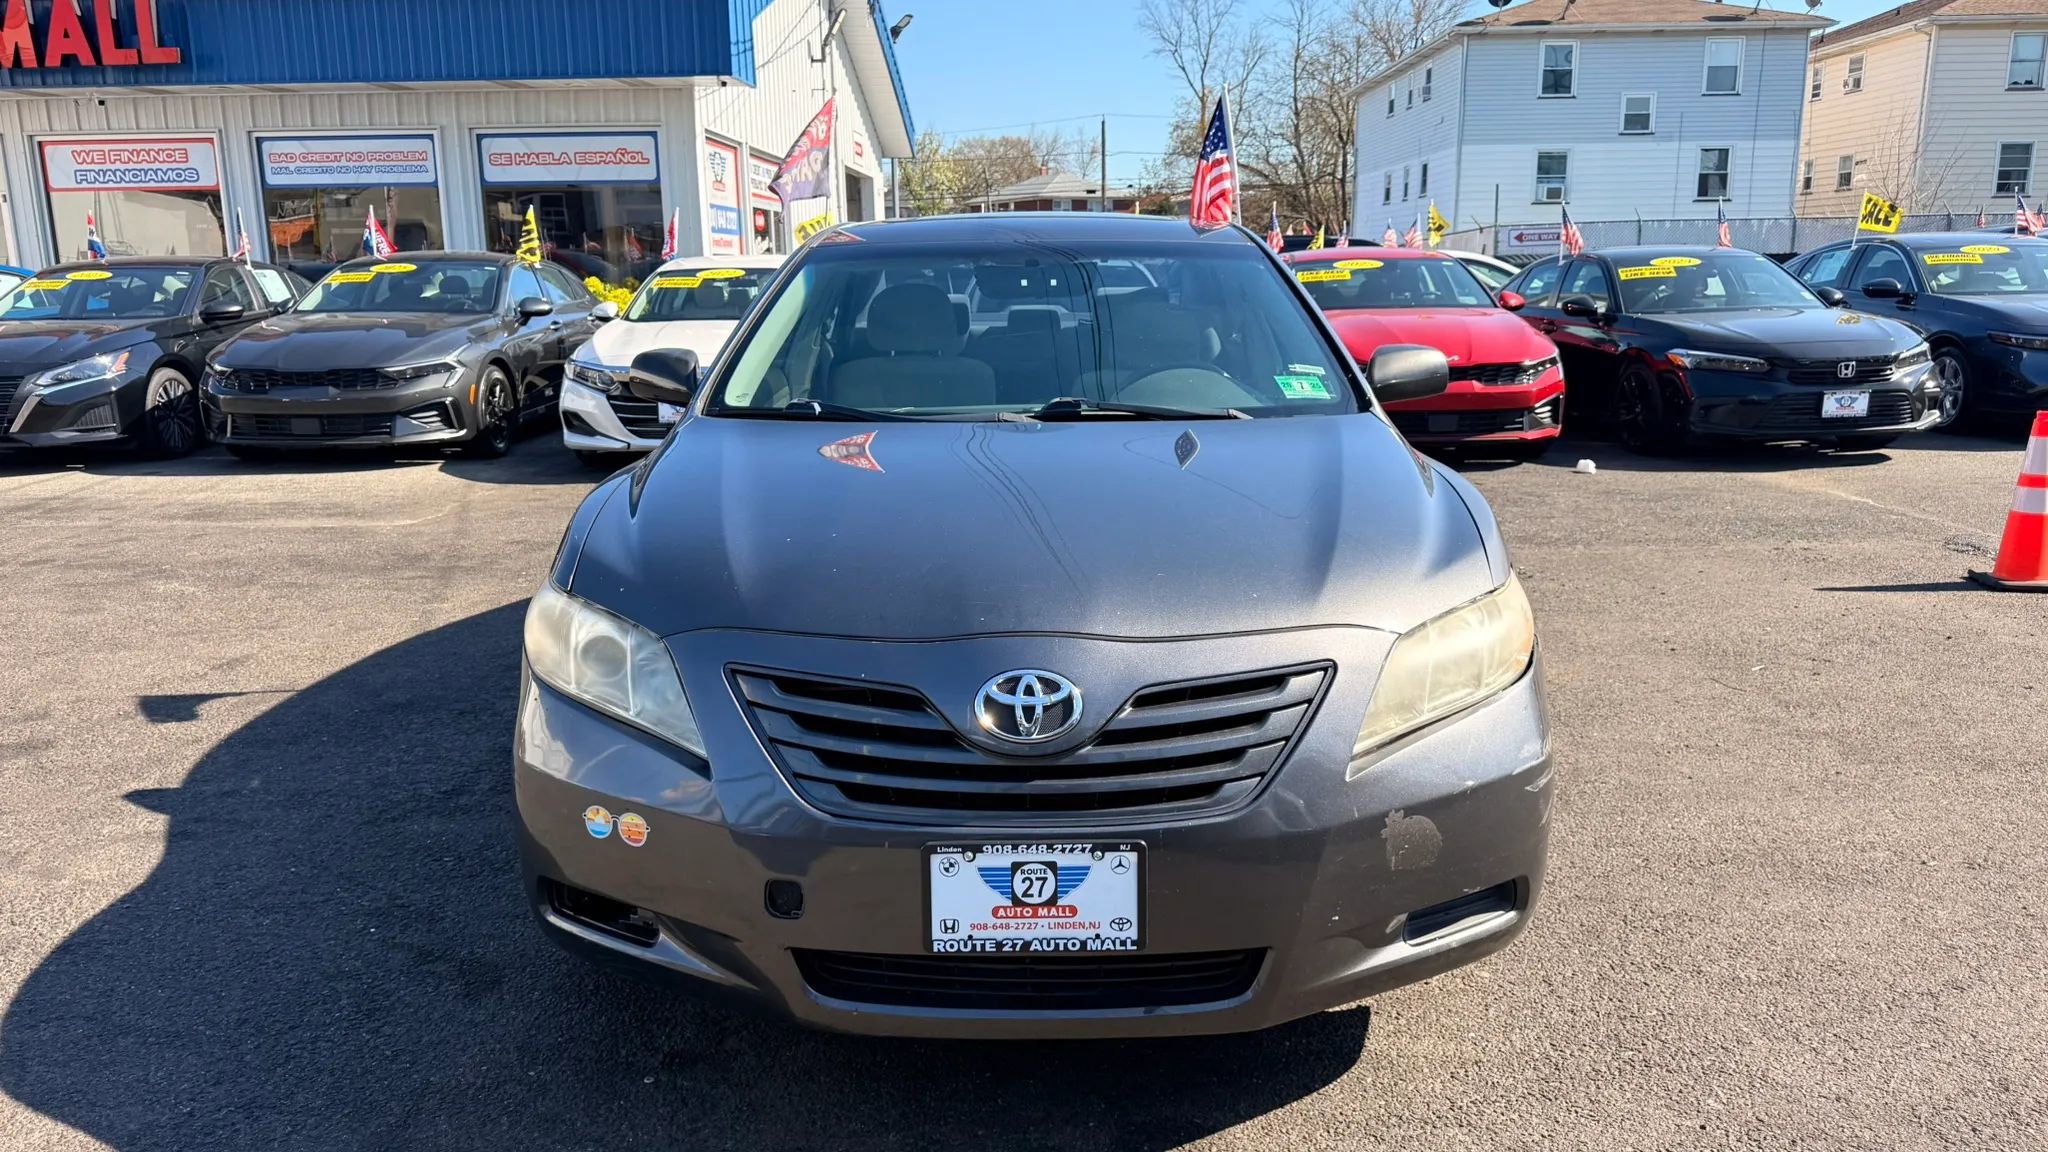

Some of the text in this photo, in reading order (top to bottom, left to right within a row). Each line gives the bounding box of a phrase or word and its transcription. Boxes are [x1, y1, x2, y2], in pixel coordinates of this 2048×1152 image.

[72, 148, 188, 164] WE FINANCE
[269, 151, 428, 163] BAD CREDIT NO PROBLEM
[489, 148, 650, 165] SE HABLA ESPAÑOL
[75, 168, 200, 184] FINANCIAMOS
[271, 165, 428, 175] MAL CREDITO NO HAY PROBLEMA
[982, 844, 1092, 855] 908-648-2727
[1021, 876, 1048, 898] 27
[997, 907, 1073, 917] AUTO MALL
[970, 921, 1101, 931] 908-648-2727 LINDEN,NJ
[933, 937, 1137, 953] ROUTE 27 AUTO MALL
